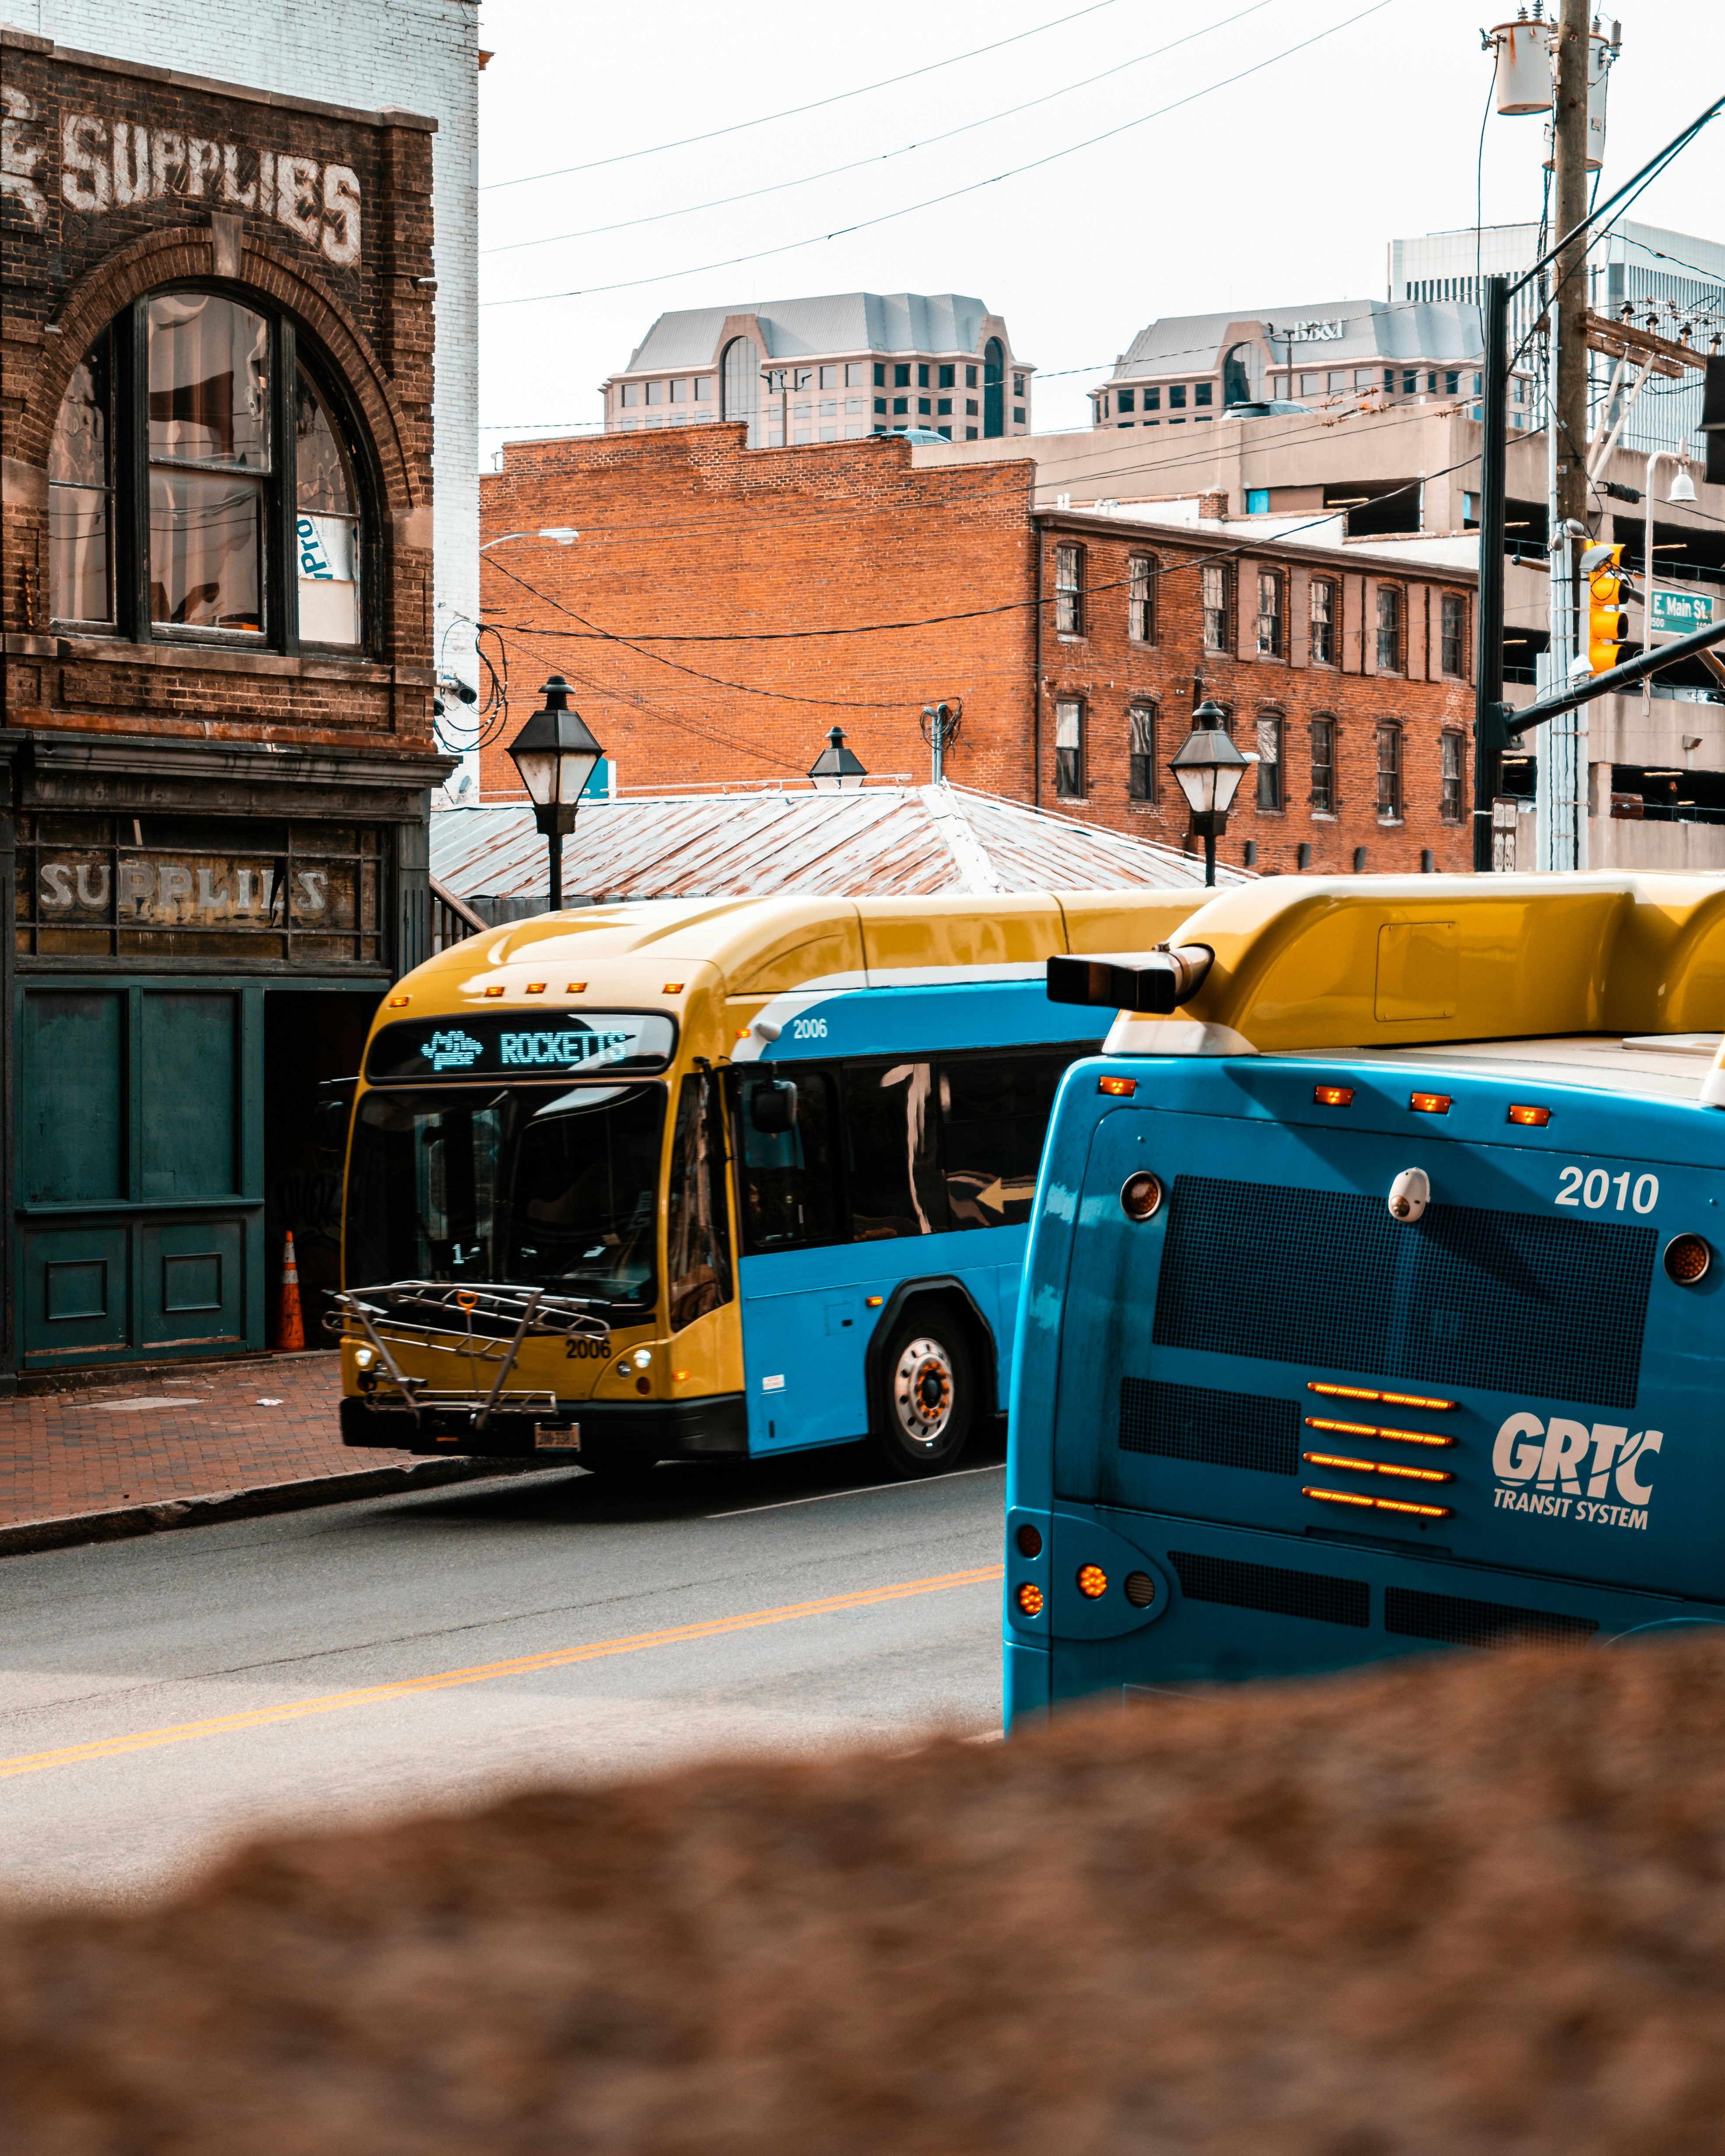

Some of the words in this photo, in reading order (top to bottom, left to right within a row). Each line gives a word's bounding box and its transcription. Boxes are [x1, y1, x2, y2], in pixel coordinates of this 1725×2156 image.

[62, 115, 360, 263] SUPPLIES
[1294, 317, 1348, 342] BB&T
[297, 519, 333, 579] Pro
[1653, 595, 1664, 615] E.
[1666, 596, 1692, 617] Main
[1693, 599, 1708, 620] St.
[793, 1018, 828, 1039] 2006
[501, 1030, 627, 1063] ROCKETTS
[1554, 1166, 1659, 1214] 2010
[452, 1244, 465, 1264] 1
[565, 1339, 612, 1359] 2006
[1492, 1412, 1664, 1505] GRTC
[1494, 1488, 1573, 1518] TRANSIT
[1575, 1501, 1648, 1530] SYSTEM
